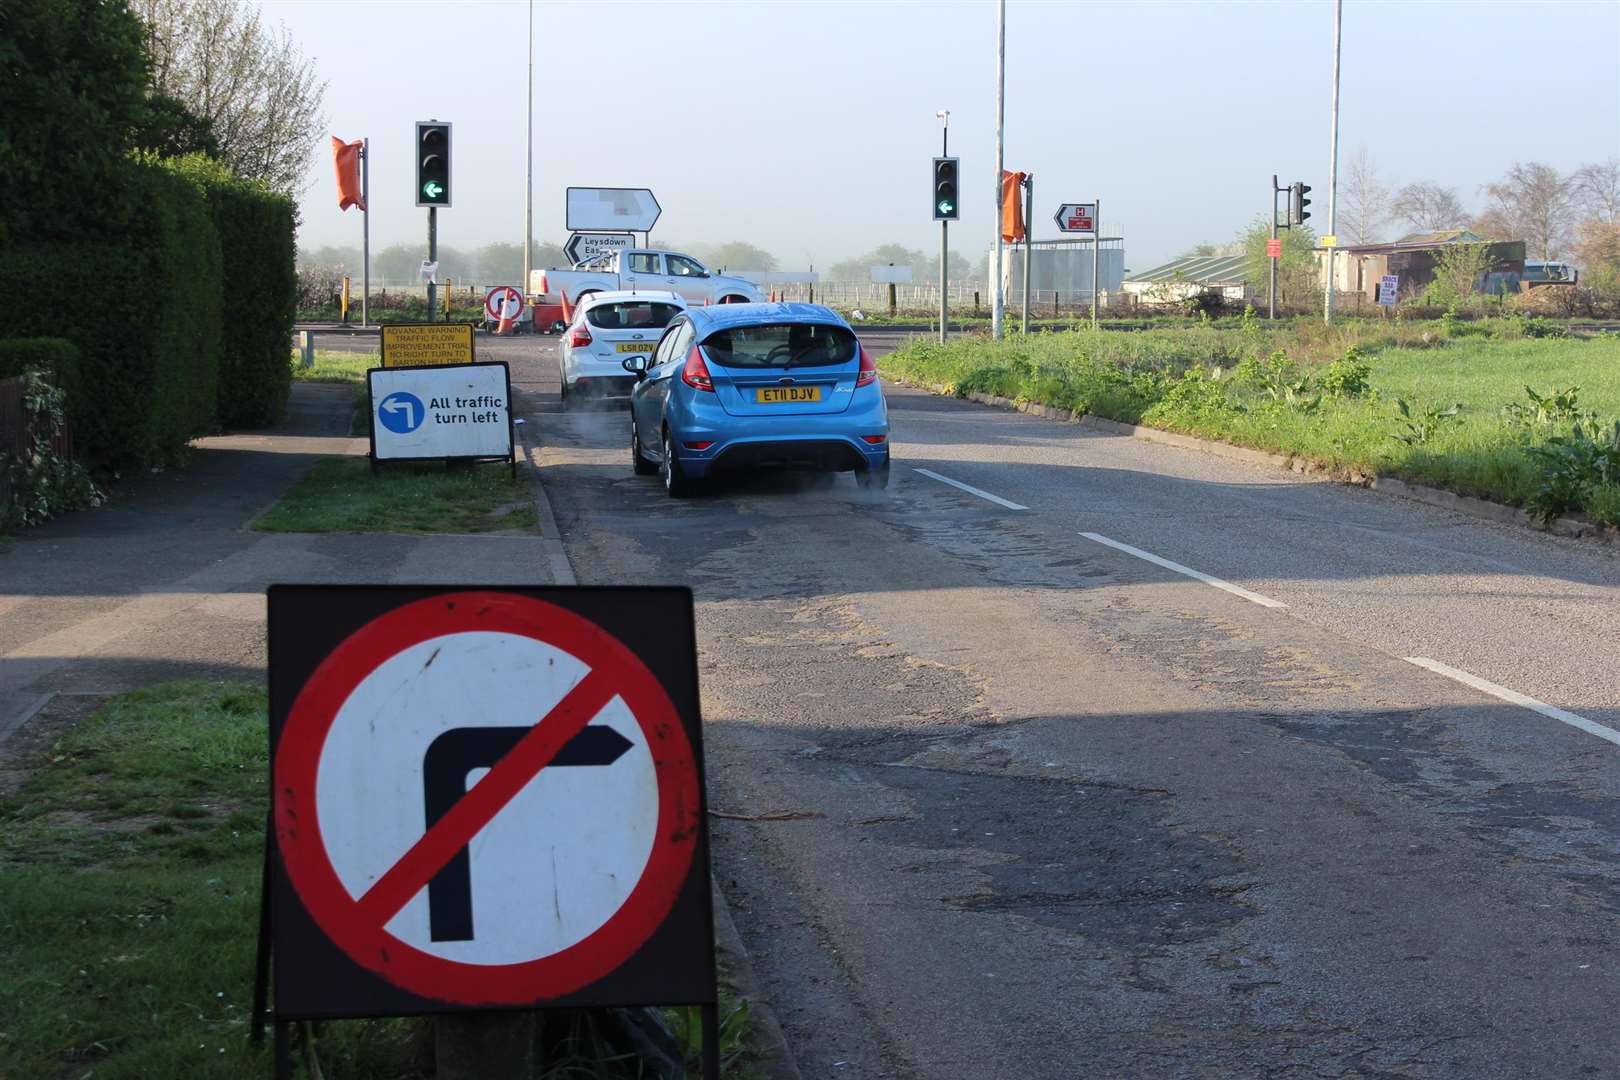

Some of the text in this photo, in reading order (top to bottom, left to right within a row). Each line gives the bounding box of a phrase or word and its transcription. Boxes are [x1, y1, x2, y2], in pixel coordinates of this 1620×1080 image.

[585, 237, 626, 246] Leysdown
[432, 334, 456, 342] FLOW
[386, 342, 470, 351] IMPROVEMENT TRIAL
[763, 388, 814, 401] ET11 DJV
[430, 396, 502, 408] All traffic
[435, 411, 499, 424] turn left
